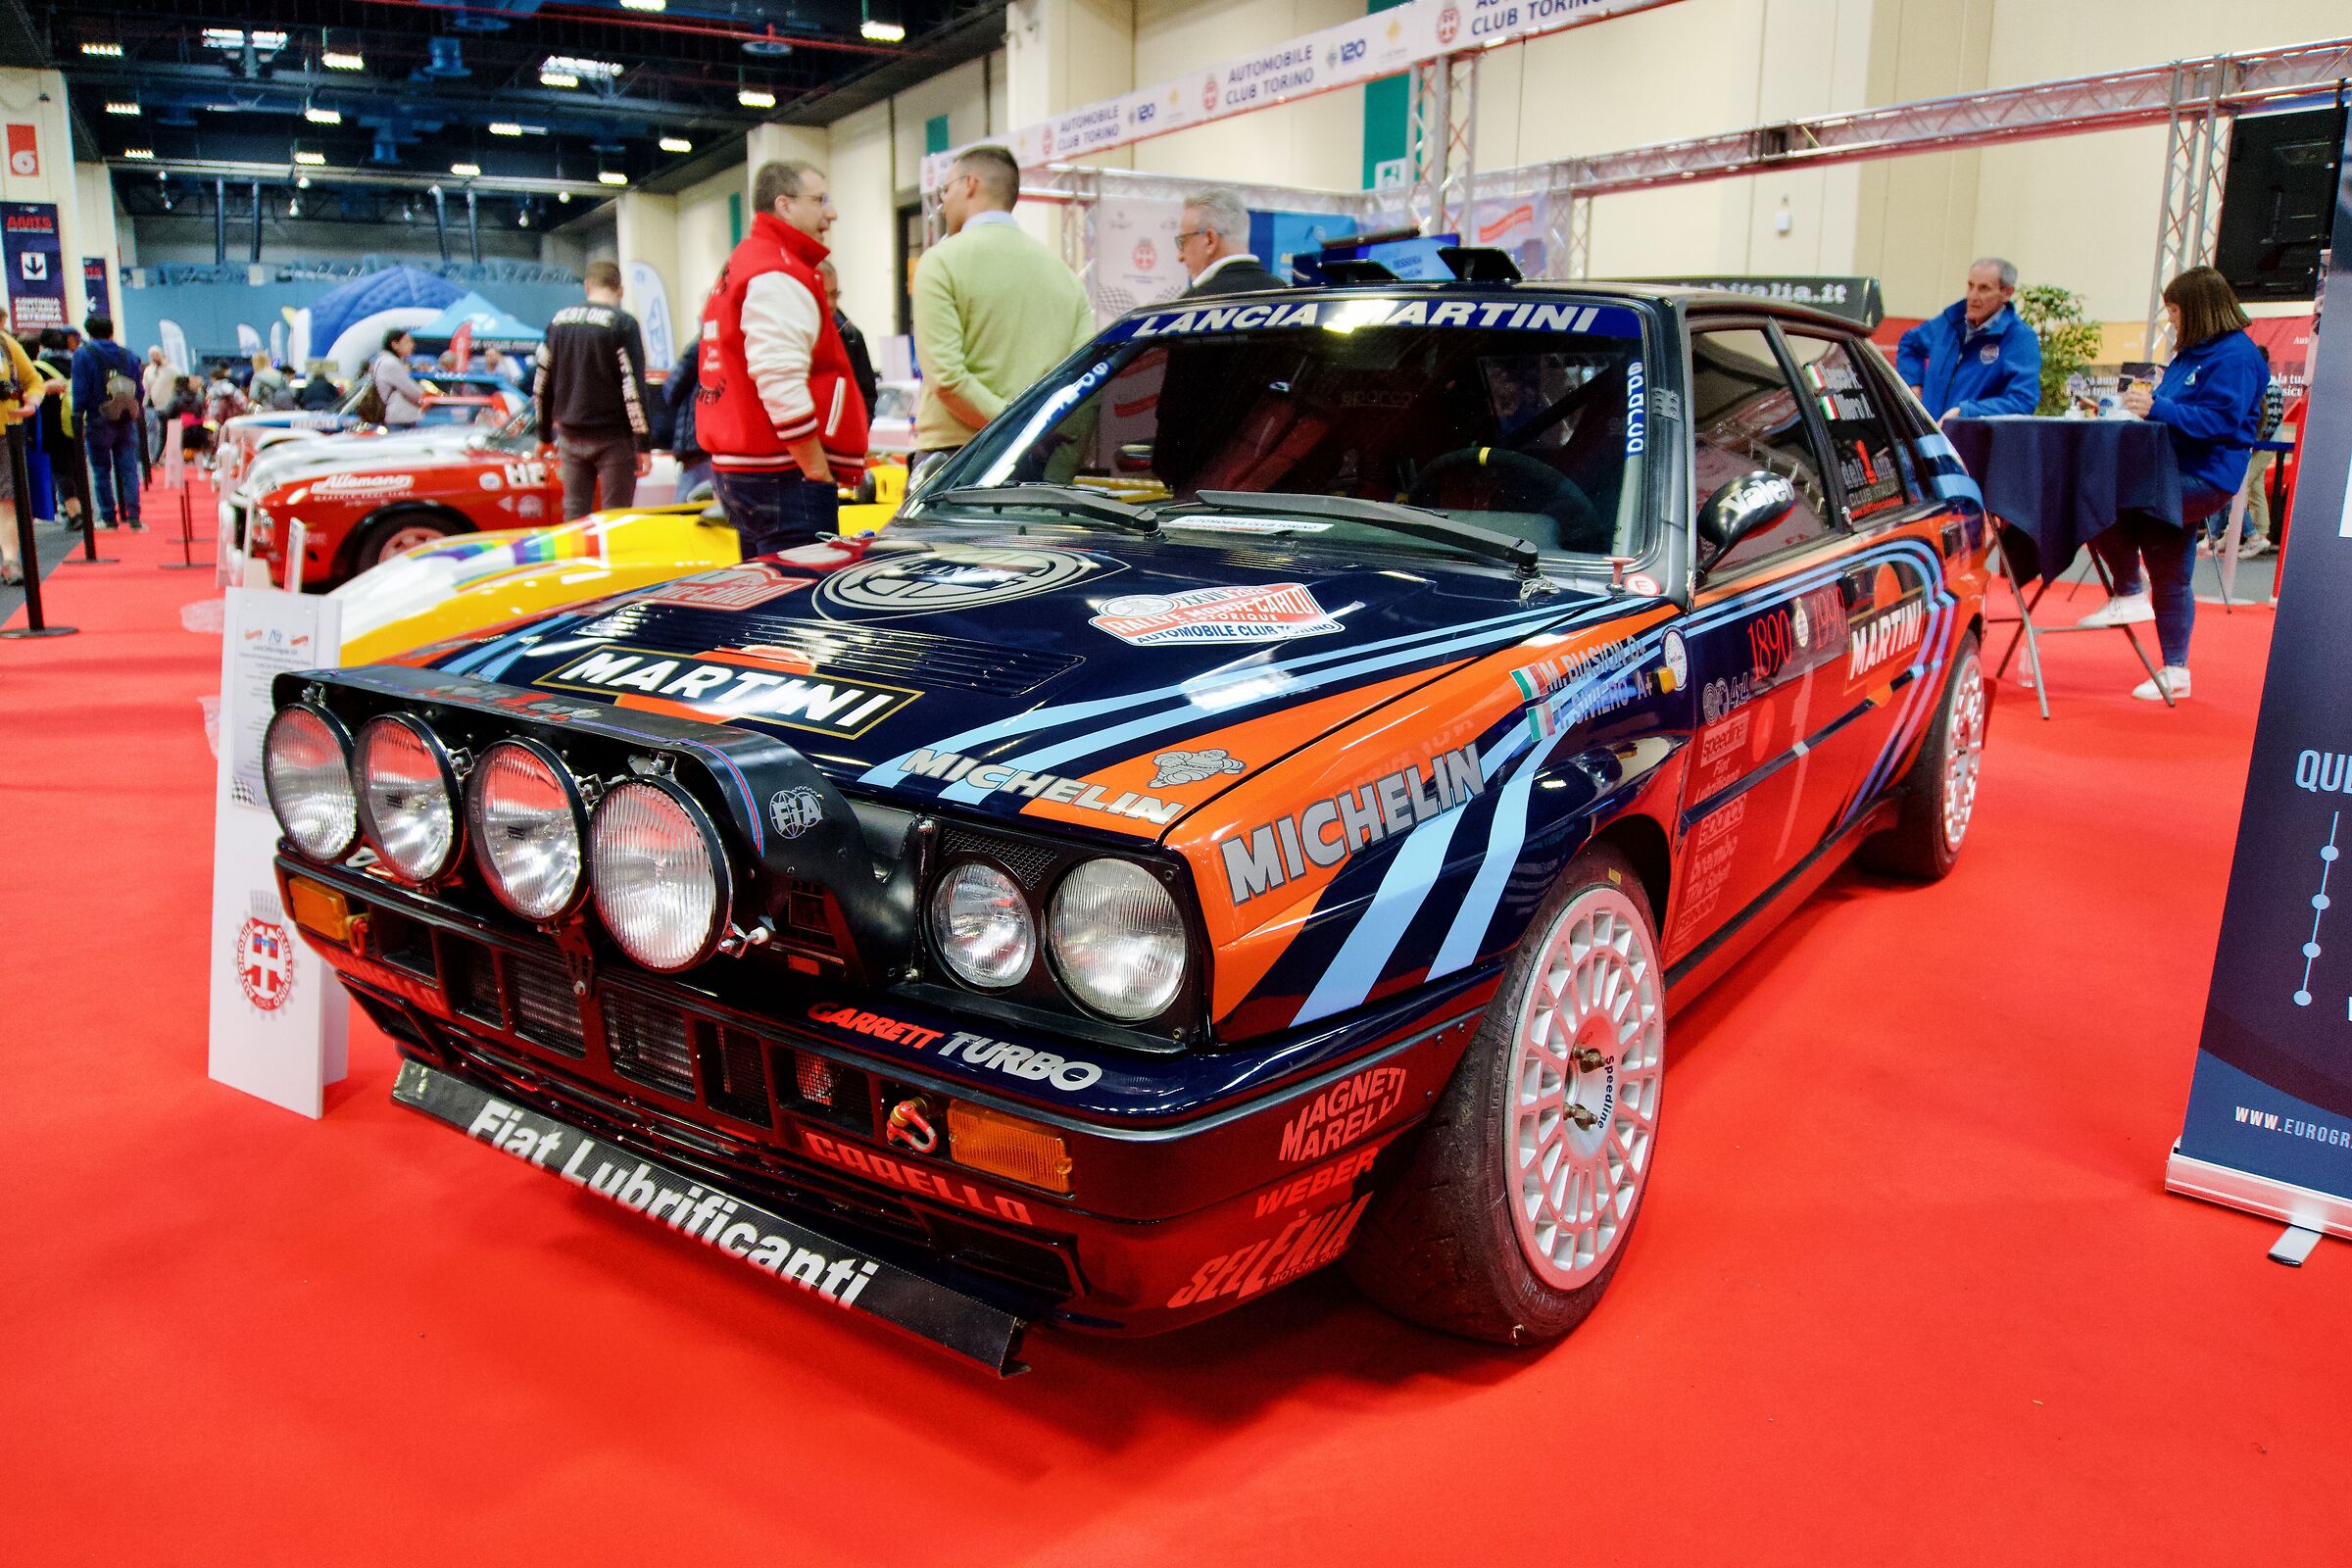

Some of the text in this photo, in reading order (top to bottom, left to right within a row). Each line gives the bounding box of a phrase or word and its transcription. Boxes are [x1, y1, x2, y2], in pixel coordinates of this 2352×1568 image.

[1471, 0, 1599, 35] CLUB TORI
[1228, 44, 1313, 83] AUTOMOBILE
[1340, 38, 1367, 64] 120
[1226, 67, 1314, 105] CLUB TORINO
[1060, 105, 1119, 133] AUTOMOBILE
[1138, 102, 1155, 122] 120
[1057, 123, 1120, 151] CLUB TORINO
[11, 150, 36, 174] 6
[1132, 299, 1600, 337] LANCIA MARTINI
[1628, 362, 1644, 453] sparco
[1717, 478, 1795, 518] Valeo
[1103, 612, 1184, 635] RALLYE
[1137, 623, 1235, 644] AUTOMOBILE
[1238, 623, 1277, 637] CLUB
[1848, 599, 1924, 681] MARTINI
[1747, 610, 1792, 682] 1890
[560, 654, 899, 727] MARTINI
[1637, 670, 1654, 702] A+
[1730, 672, 1750, 710] 4x4
[897, 749, 1187, 827] MICHELIN
[1219, 742, 1485, 907] MICHELIN
[237, 918, 292, 1007] AUTOMOBILE CLUB TORINO
[807, 1001, 1103, 1091] GARRETT TURBO
[1597, 1054, 1615, 1129] Speedline
[2235, 1105, 2352, 1151] WWW.EUROGR
[805, 1129, 1034, 1226] CARELLO
[1253, 1147, 1379, 1219] WEBER
[467, 1099, 881, 1311] Fiat Lubrificanti
[1267, 1248, 1340, 1287] MOTOR OIL
